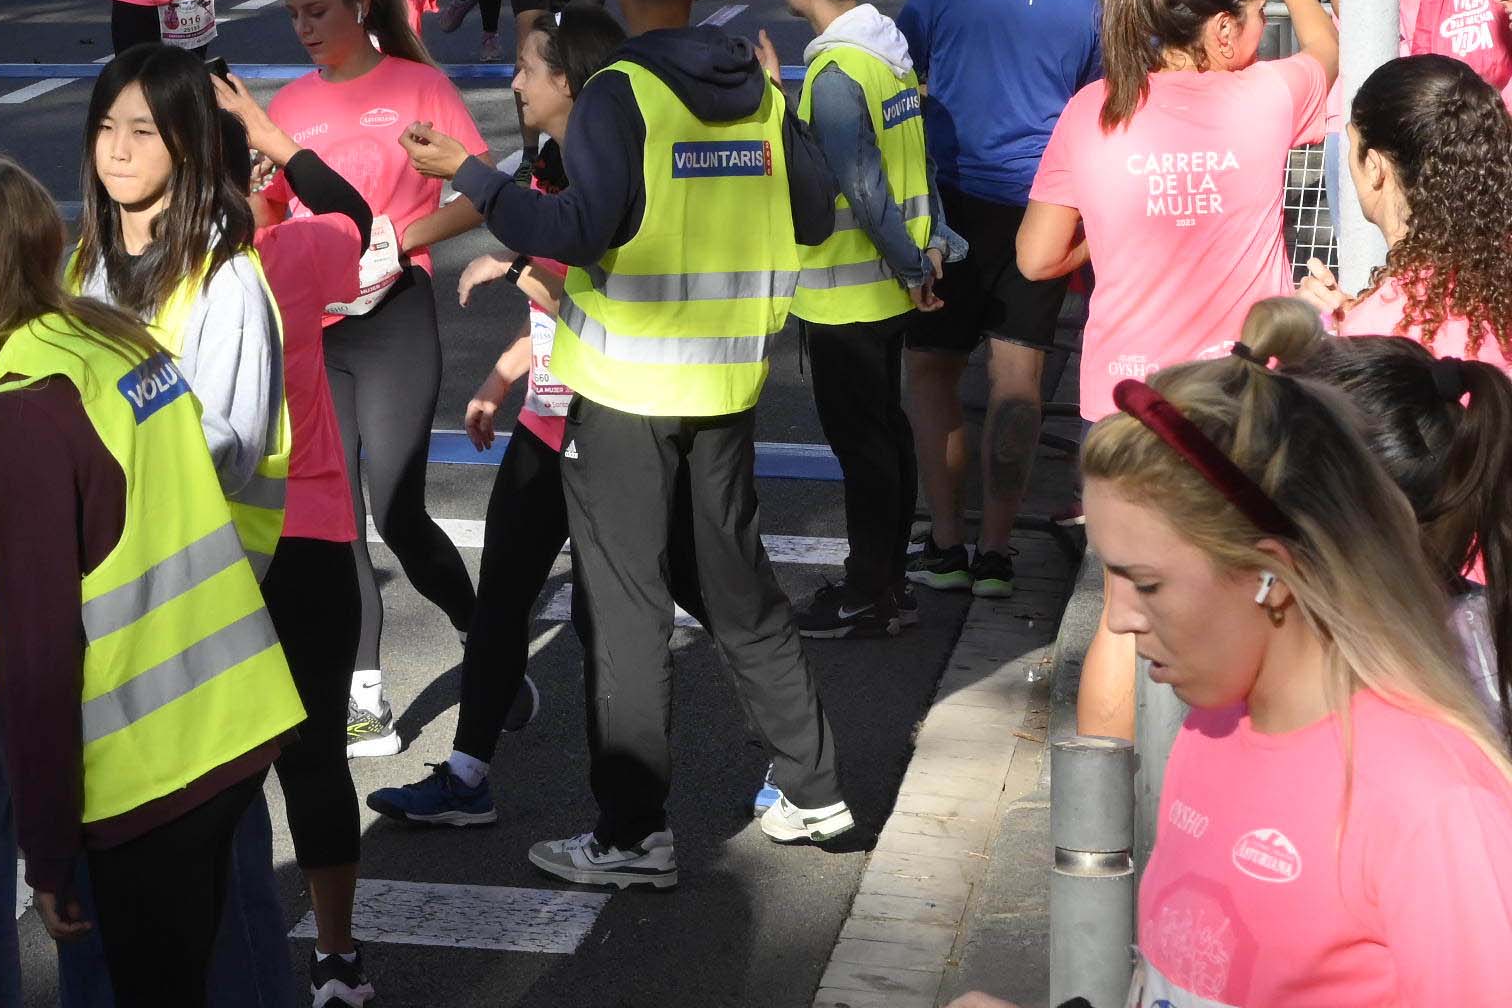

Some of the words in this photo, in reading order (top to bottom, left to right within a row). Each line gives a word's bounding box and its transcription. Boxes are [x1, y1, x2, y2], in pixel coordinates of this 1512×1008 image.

[181, 15, 200, 26] 016
[293, 123, 329, 142] OYSHO
[674, 150, 764, 169] VOLUNTARIS
[1127, 151, 1240, 175] CARRERA
[1149, 174, 1177, 195] DE
[1187, 173, 1217, 193] LA
[1146, 194, 1223, 216] MUJER
[128, 362, 182, 408] VOLU
